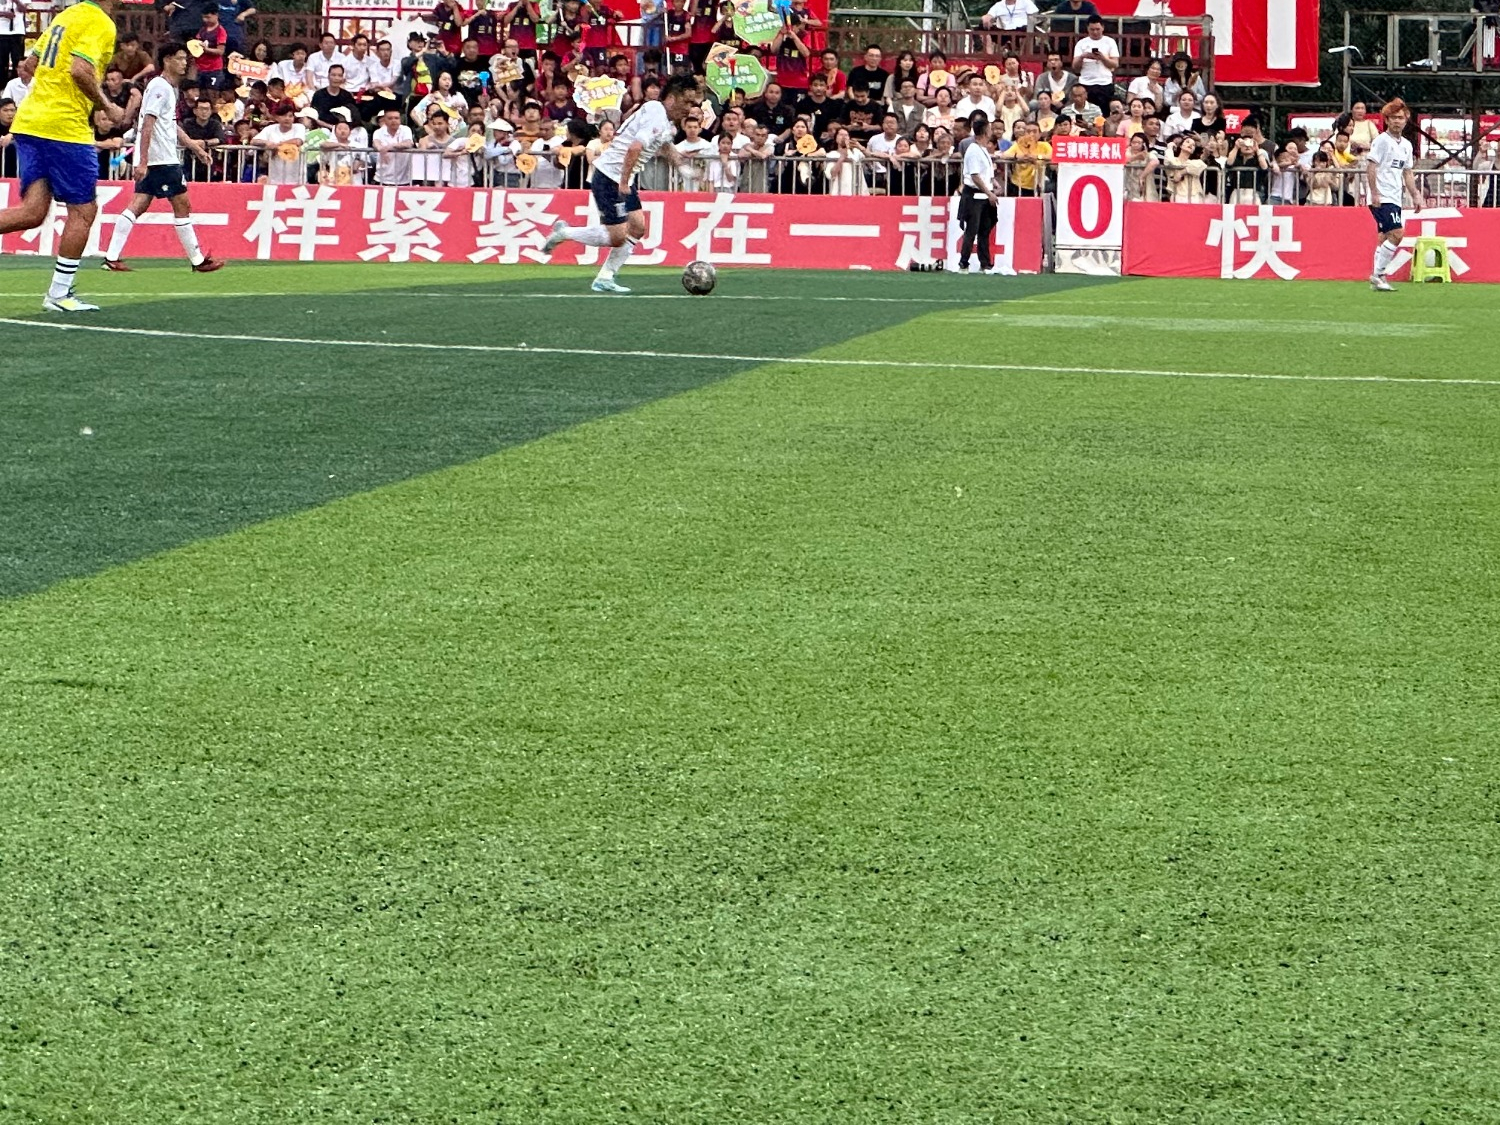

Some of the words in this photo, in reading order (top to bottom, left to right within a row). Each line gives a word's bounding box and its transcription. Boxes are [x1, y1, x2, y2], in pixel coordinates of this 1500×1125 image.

[1056, 141, 1122, 159] 三穗鸭美食队
[0, 182, 948, 271] 一样紧紧抱在一起
[1067, 174, 1113, 240] 0
